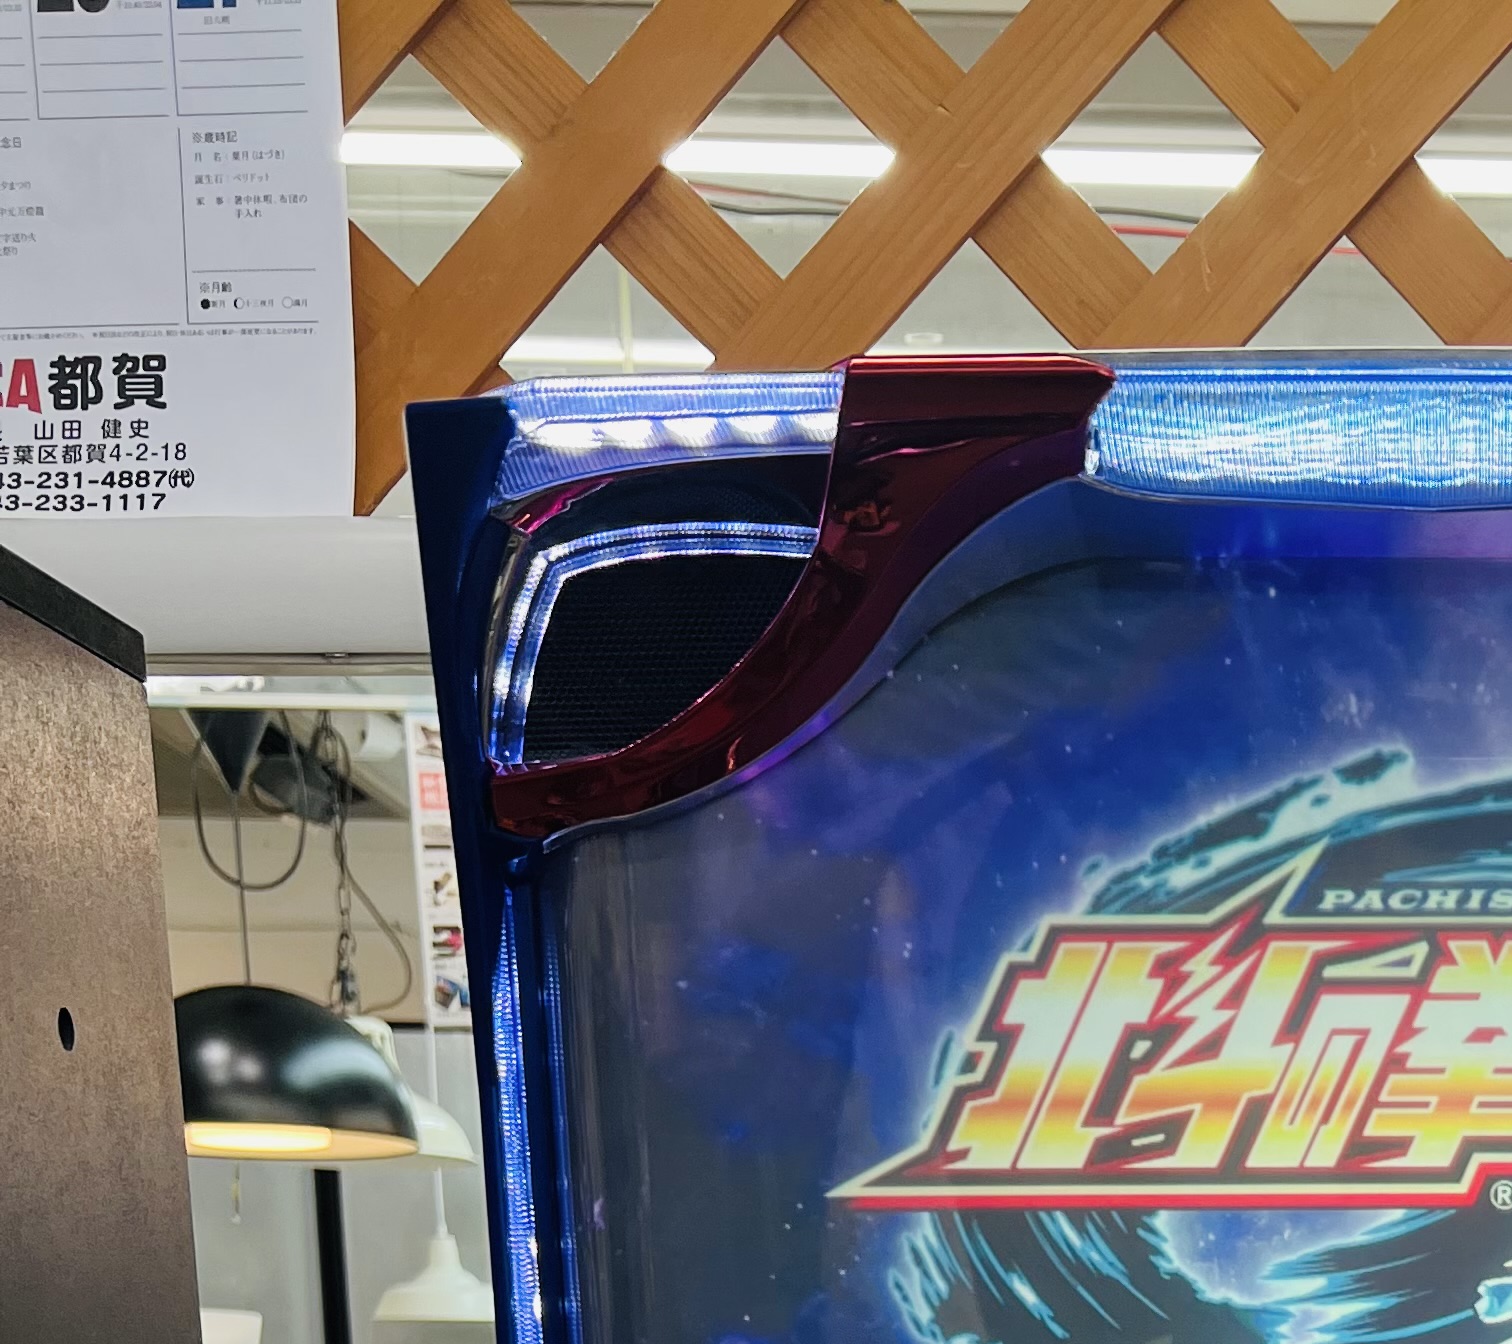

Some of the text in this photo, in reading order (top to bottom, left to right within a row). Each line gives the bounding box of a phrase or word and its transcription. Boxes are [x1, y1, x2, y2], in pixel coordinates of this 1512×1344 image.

[0, 353, 167, 414] A都賀
[34, 419, 82, 440] 山田
[0, 492, 167, 512] 3-233-1117
